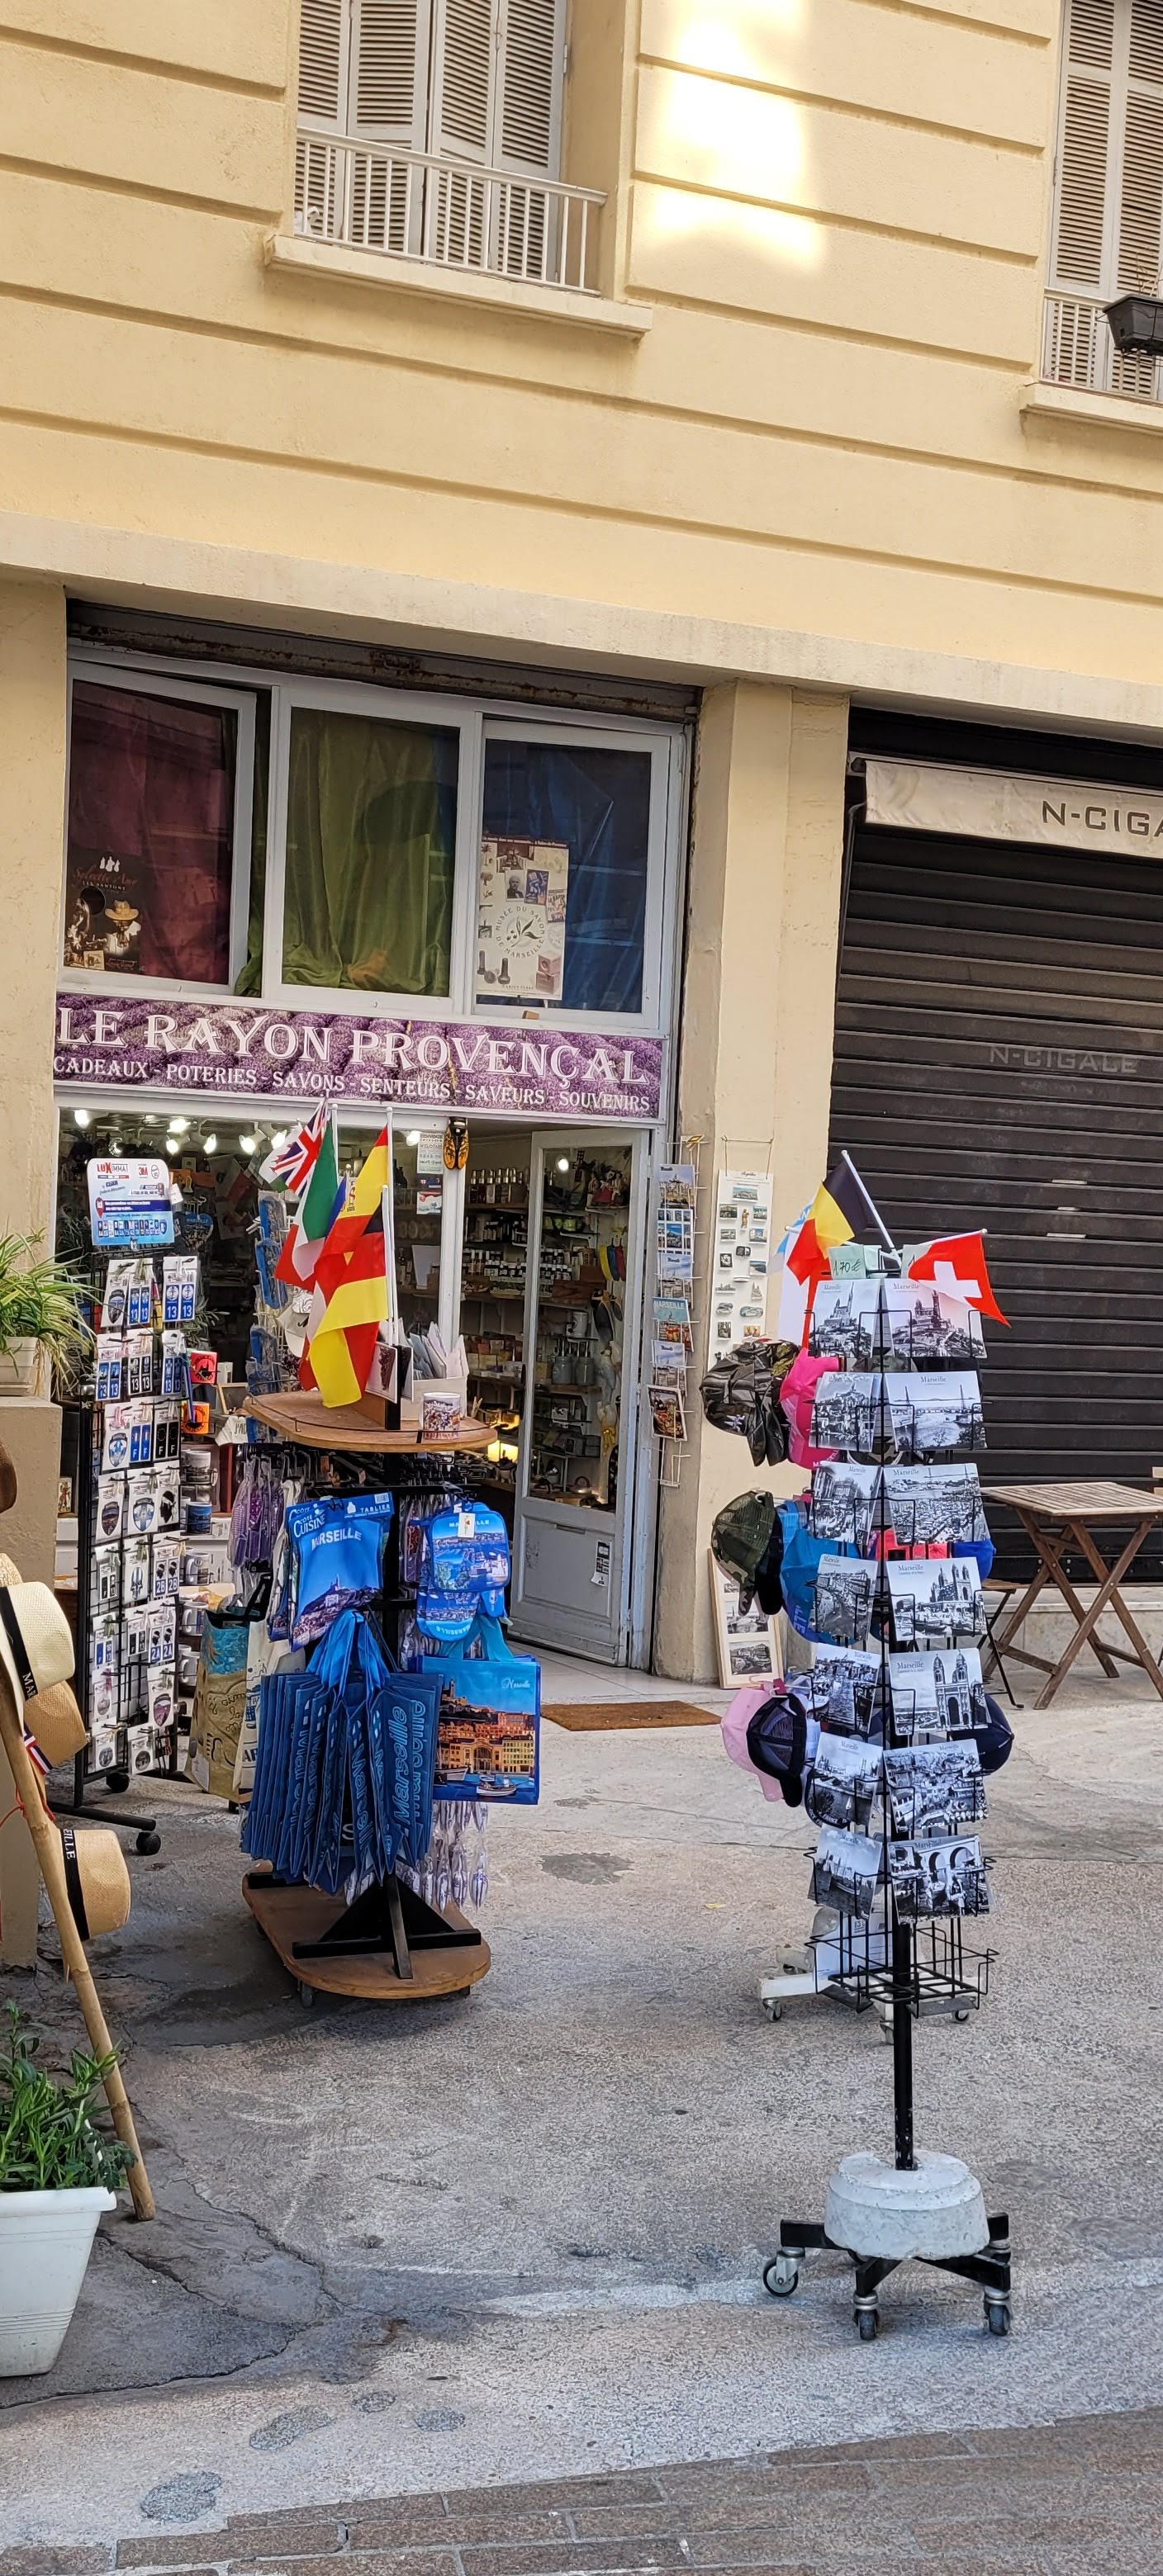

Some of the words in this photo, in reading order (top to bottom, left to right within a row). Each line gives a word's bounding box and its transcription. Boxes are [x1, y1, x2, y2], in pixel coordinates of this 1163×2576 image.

[505, 940, 544, 959] MARSEILLE
[56, 1006, 128, 1049] LE
[144, 1014, 334, 1063] RAYON
[348, 1029, 651, 1089] PROVENÇAL
[990, 1045, 1138, 1074] N-CIGALE
[54, 1056, 149, 1079] CADEAUX
[166, 1063, 257, 1085] POTERIES
[273, 1073, 345, 1091] SAVONS
[360, 1077, 451, 1099] SENTEURS
[465, 1084, 546, 1106] SAVEURS
[559, 1091, 650, 1111] SOUVENIRS
[138, 1167, 149, 1176] 3M
[141, 1307, 149, 1320] 13
[167, 1305, 177, 1319] 13
[183, 1305, 192, 1318] 13
[111, 1383, 119, 1396] 13
[132, 1378, 139, 1391] 13
[142, 1376, 150, 1390] 13
[165, 1379, 172, 1392] 13
[133, 1448, 138, 1458] F
[143, 1447, 148, 1457] F
[159, 1446, 164, 1456] F
[170, 1444, 176, 1454] F
[360, 1503, 391, 1513] TABLIER
[293, 1513, 325, 1538] CUISINE
[449, 1519, 490, 1527] MALLE
[156, 1580, 165, 1593] 2B
[168, 1578, 178, 1591] 2B
[151, 1647, 160, 1660] 2A
[164, 1645, 173, 1658] 2A
[897, 1660, 924, 1669] Marseille
[21, 1672, 36, 1698] MAR
[388, 1706, 411, 1825] Marseille
